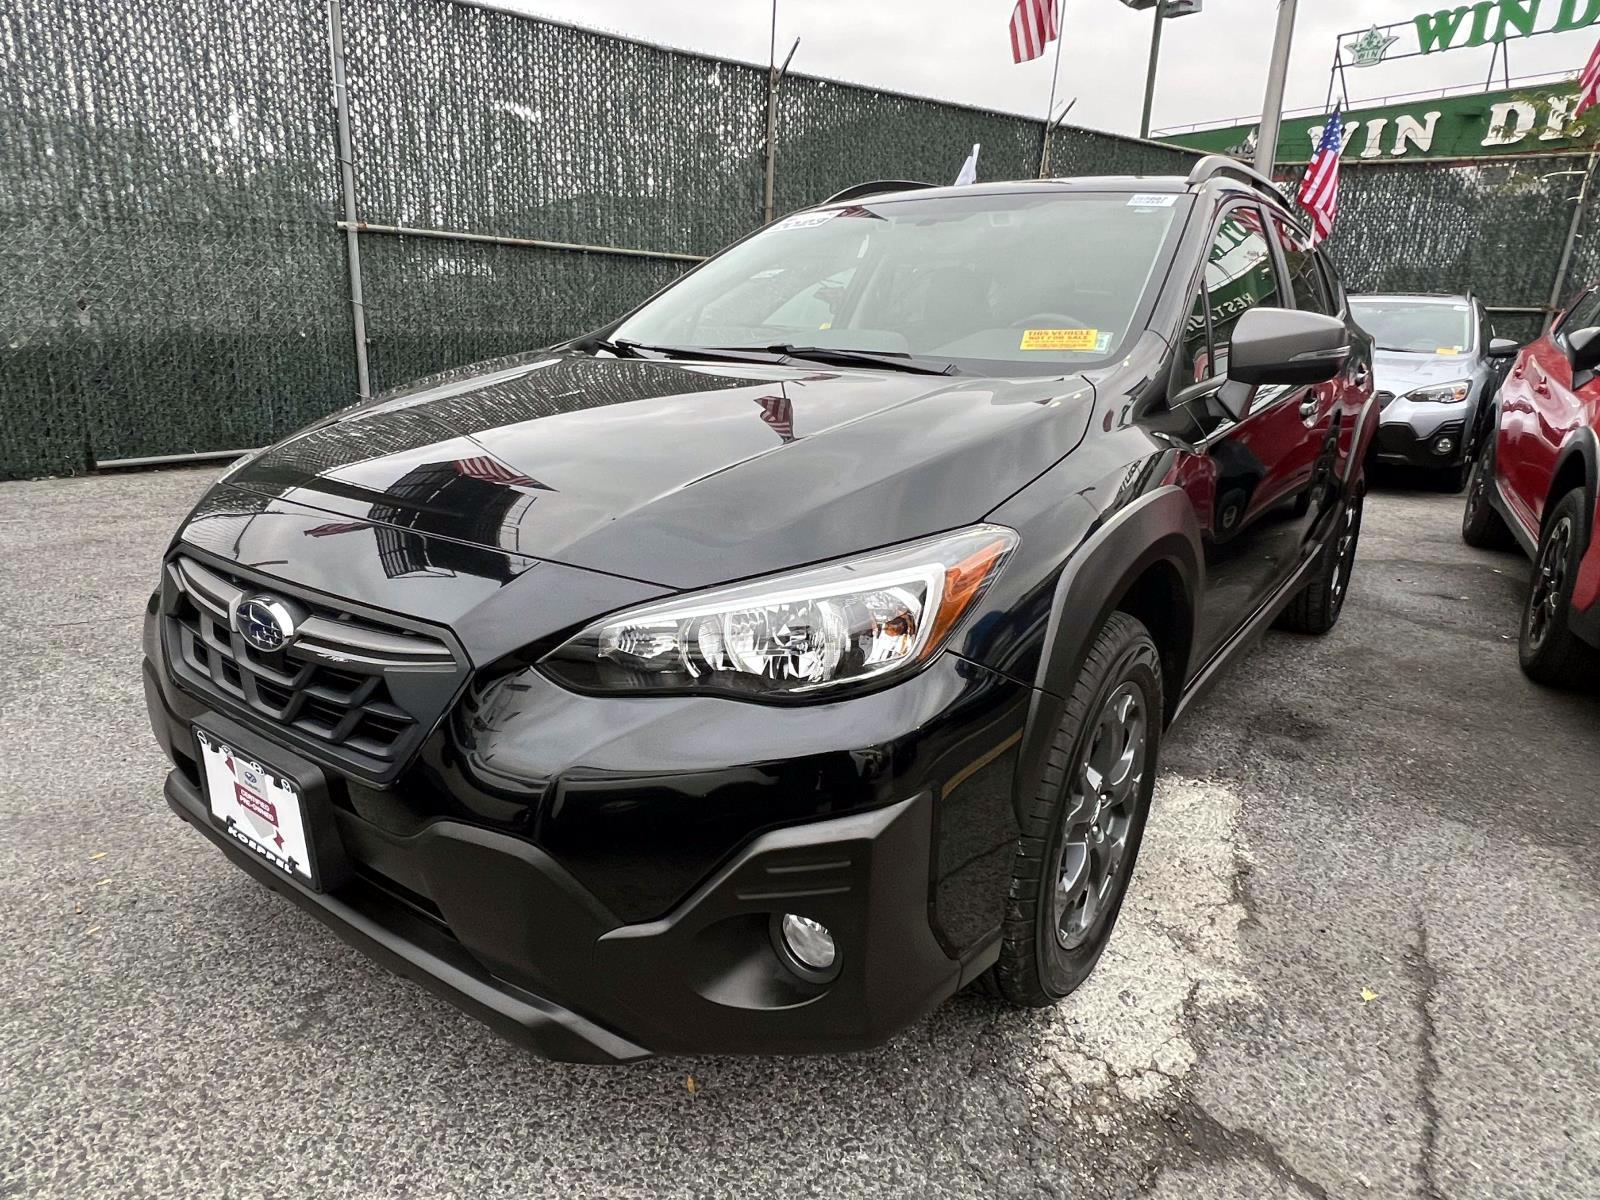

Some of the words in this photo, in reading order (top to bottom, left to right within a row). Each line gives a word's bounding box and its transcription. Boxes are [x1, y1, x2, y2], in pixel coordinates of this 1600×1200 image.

[1414, 0, 1540, 55] WIN
[1358, 50, 1379, 60] WIN
[227, 826, 293, 875] KOEPPEL
